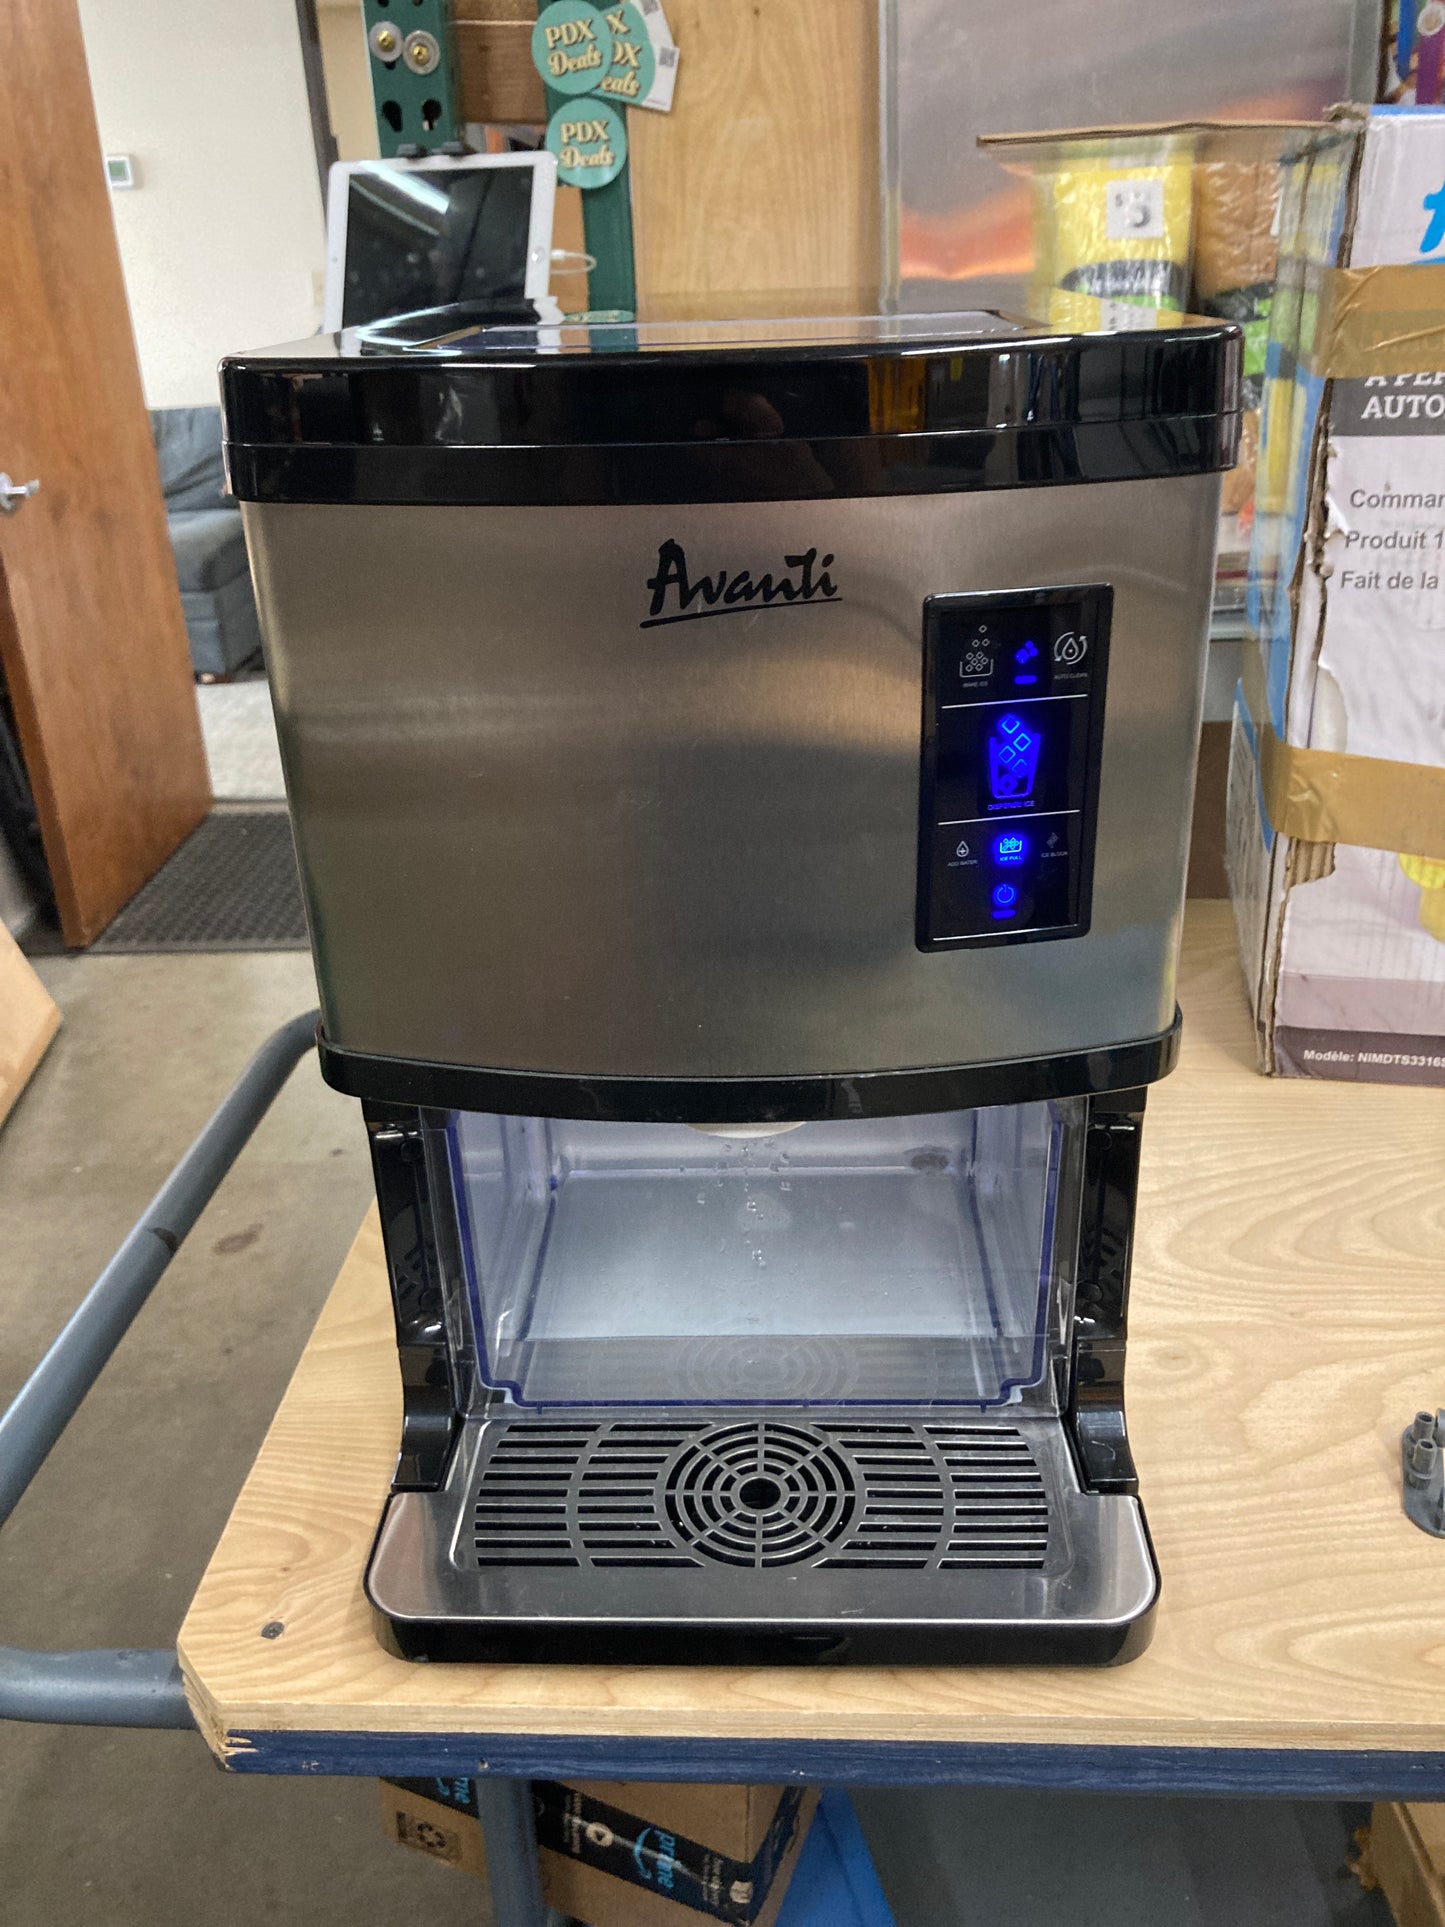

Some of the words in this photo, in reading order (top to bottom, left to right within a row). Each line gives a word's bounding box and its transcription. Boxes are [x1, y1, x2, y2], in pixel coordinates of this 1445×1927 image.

[545, 19, 596, 49] PDX
[548, 43, 602, 76] Deals
[600, 70, 641, 98] eals
[560, 119, 611, 145] PDX
[560, 144, 615, 170] Deals
[1344, 528, 1427, 551] Produit
[645, 538, 840, 617] Avanti
[1340, 570, 1380, 591] Fait
[1387, 570, 1413, 591] de
[1420, 569, 1440, 591] la
[1303, 1049, 1355, 1063] Modèle:
